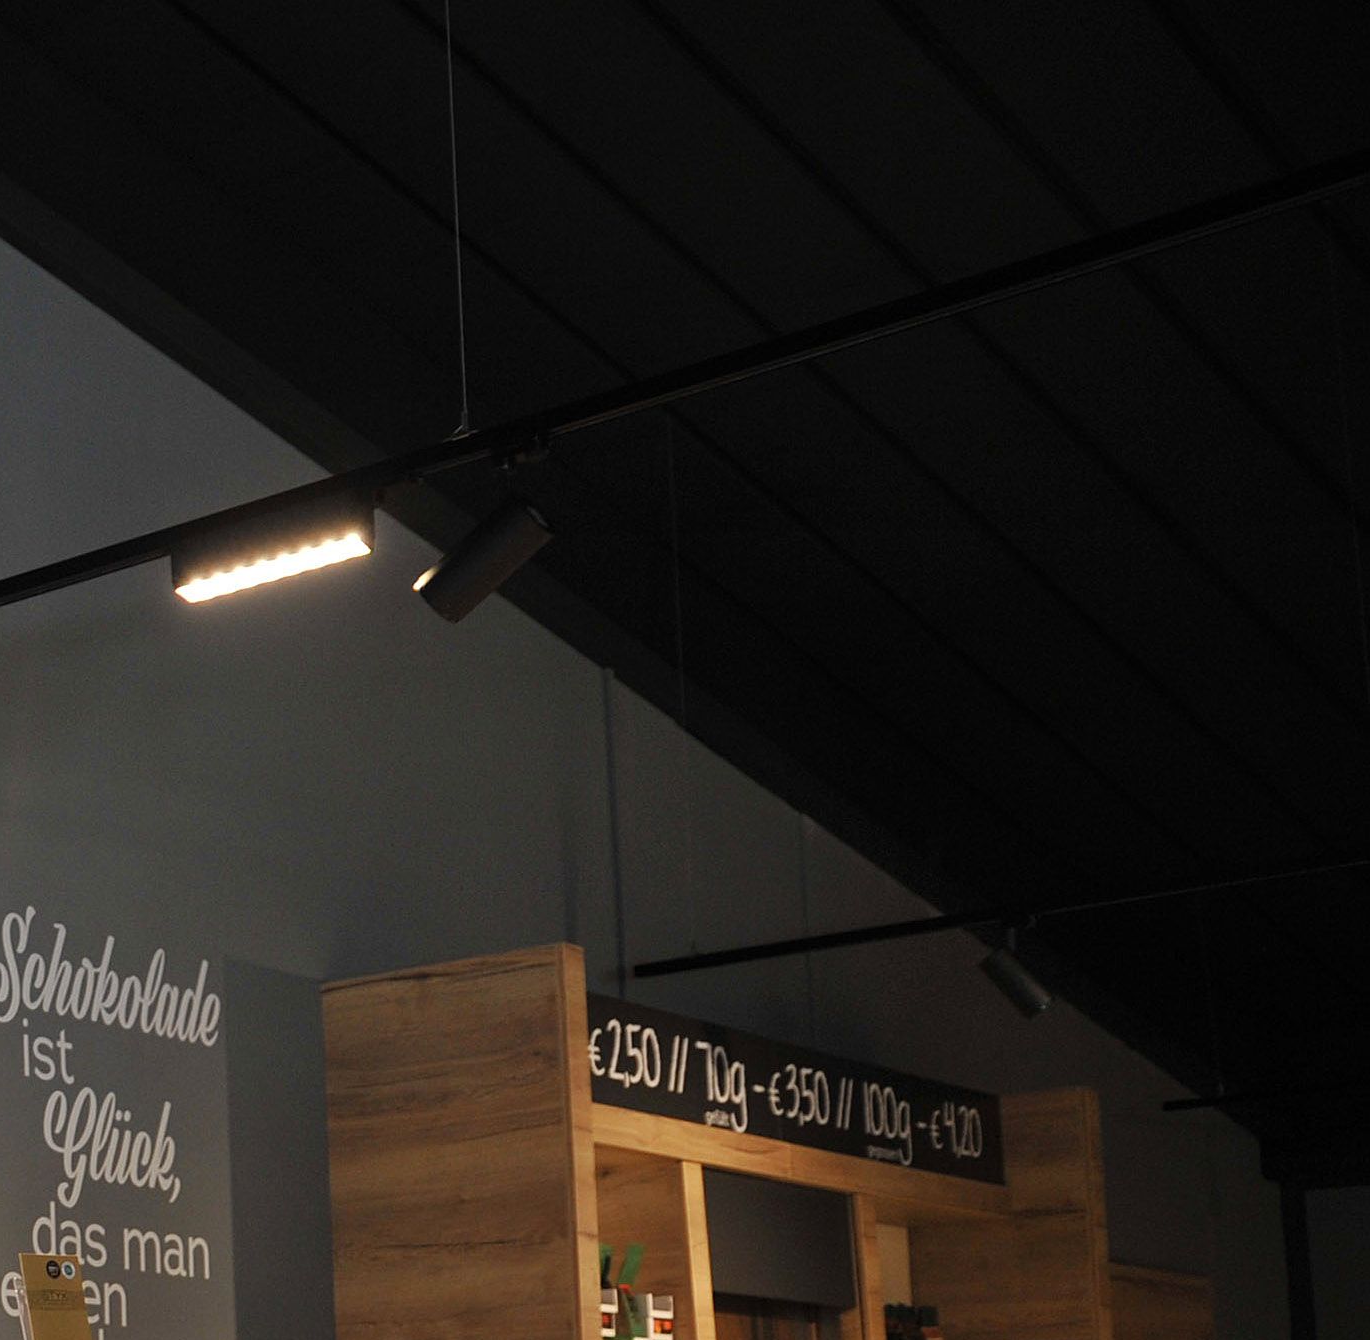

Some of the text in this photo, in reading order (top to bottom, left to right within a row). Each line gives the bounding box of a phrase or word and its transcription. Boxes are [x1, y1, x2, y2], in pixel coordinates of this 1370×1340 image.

[22, 1018, 75, 1085] ist
[694, 1040, 748, 1133] 70g
[863, 1081, 913, 1166] 100g
[43, 1085, 182, 1208] Glück,
[32, 1201, 211, 1280] das man
[0, 1271, 128, 1328] een
